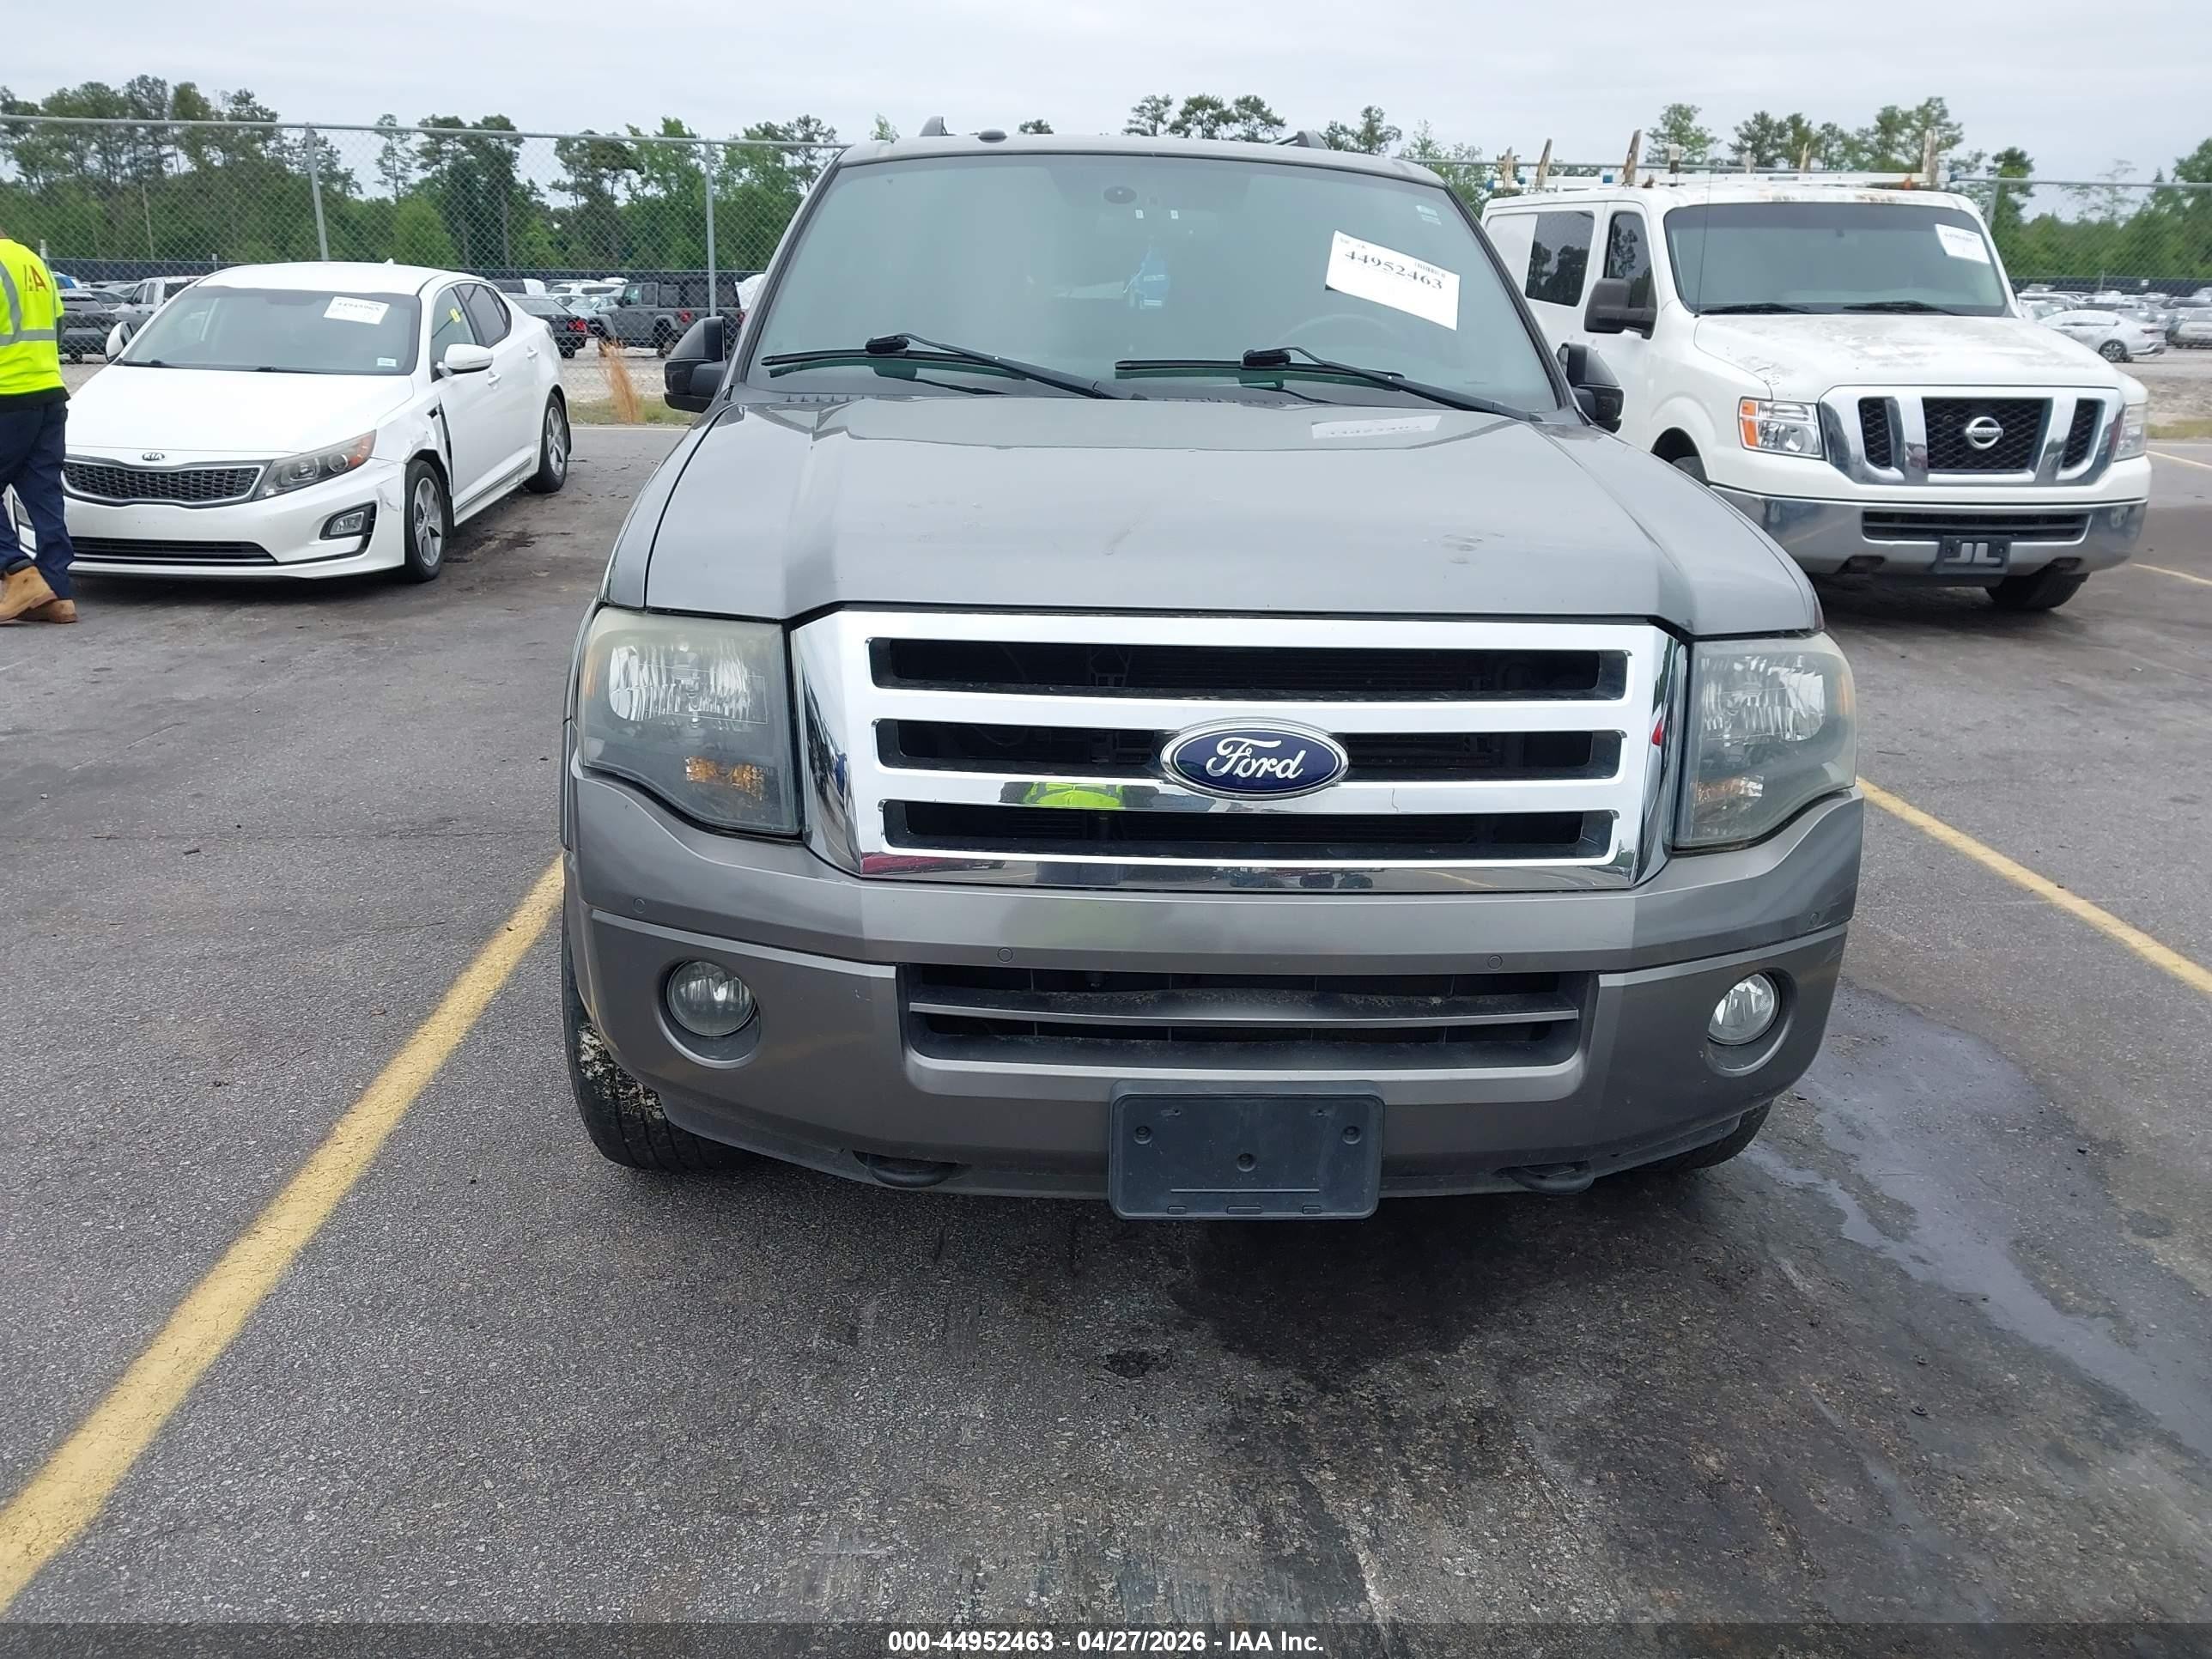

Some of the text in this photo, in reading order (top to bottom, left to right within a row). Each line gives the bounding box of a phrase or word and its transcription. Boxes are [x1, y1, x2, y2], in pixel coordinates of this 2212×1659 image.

[1345, 250, 1443, 289] 44952463
[143, 453, 163, 461] KIA
[1205, 737, 1307, 780] Ford
